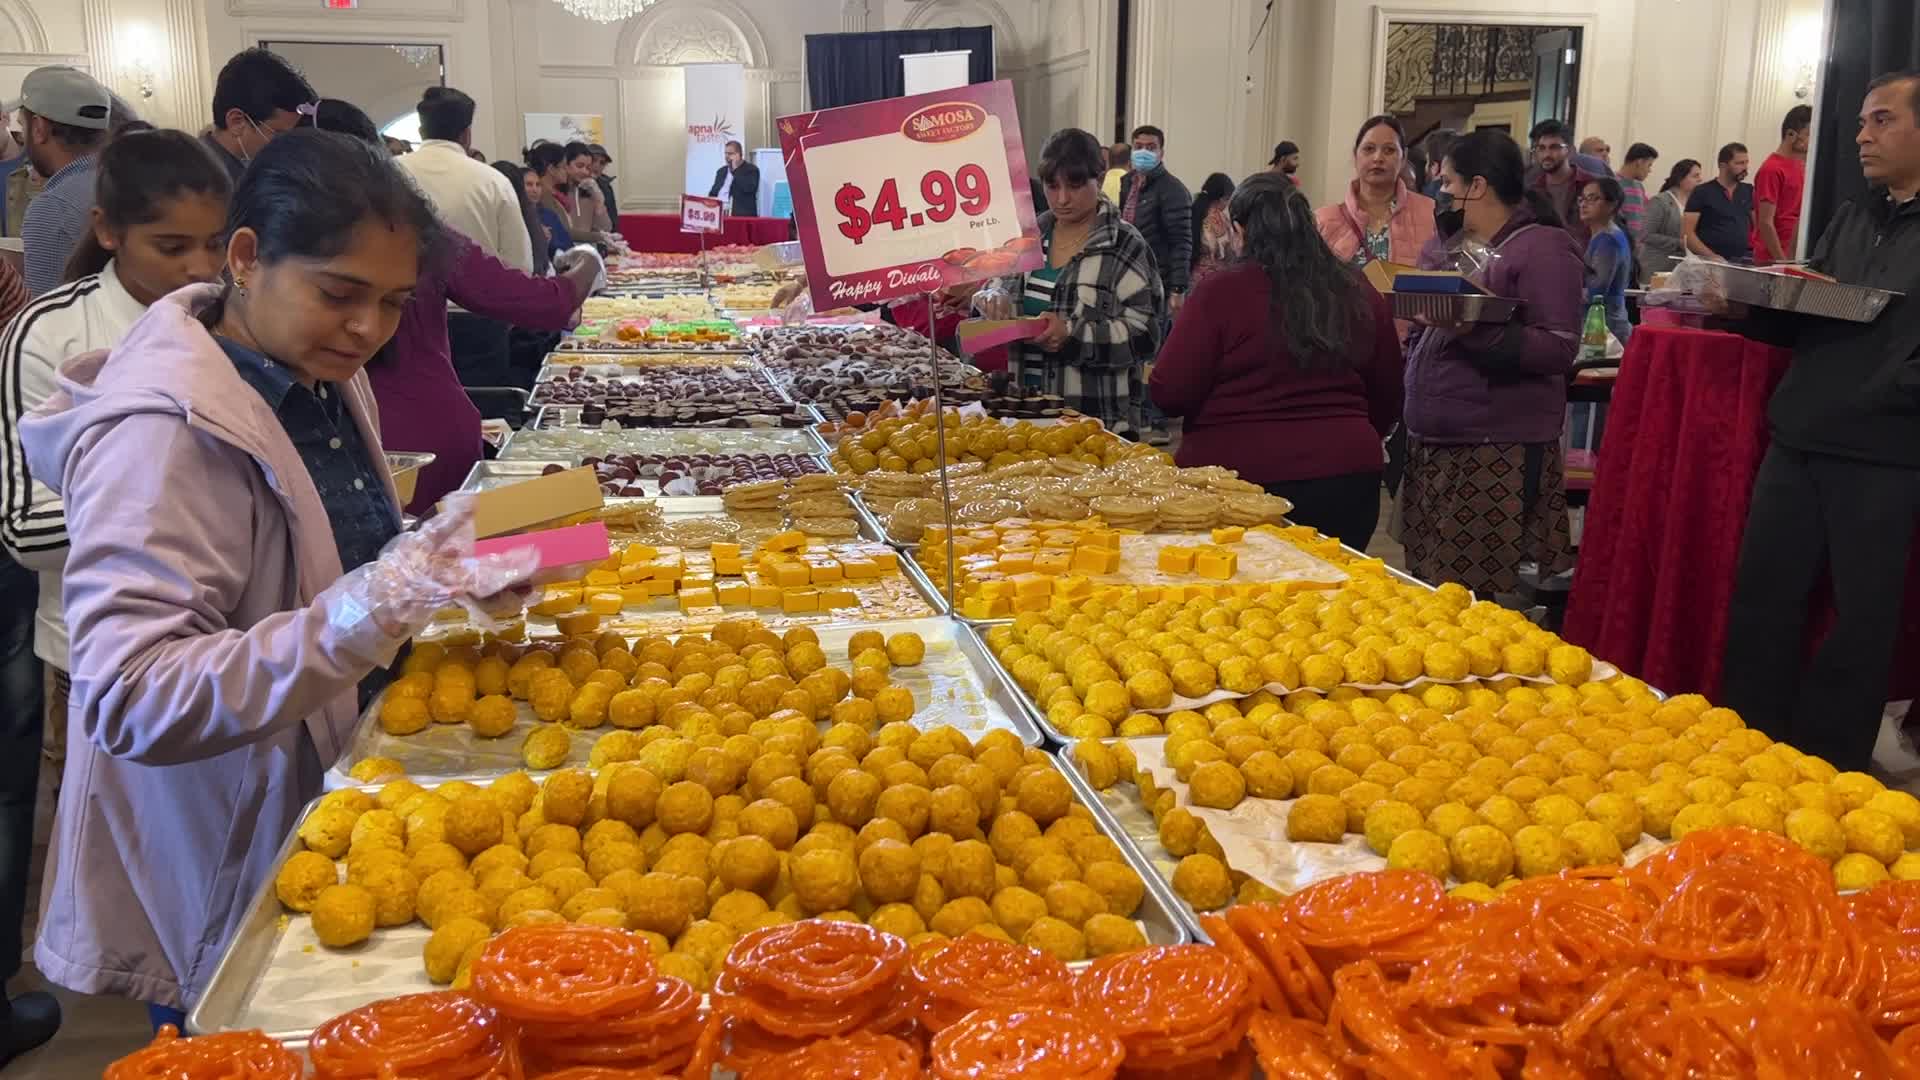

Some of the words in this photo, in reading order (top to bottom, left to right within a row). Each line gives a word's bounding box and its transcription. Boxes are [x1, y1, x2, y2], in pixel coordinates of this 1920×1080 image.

[912, 109, 975, 131] SAMOSA
[687, 208, 716, 222] $5.99
[834, 163, 991, 245] $4.99
[969, 219, 984, 229] Per
[986, 217, 1001, 226] Lb.
[829, 280, 882, 300] Happy
[887, 266, 940, 289] Diwali
